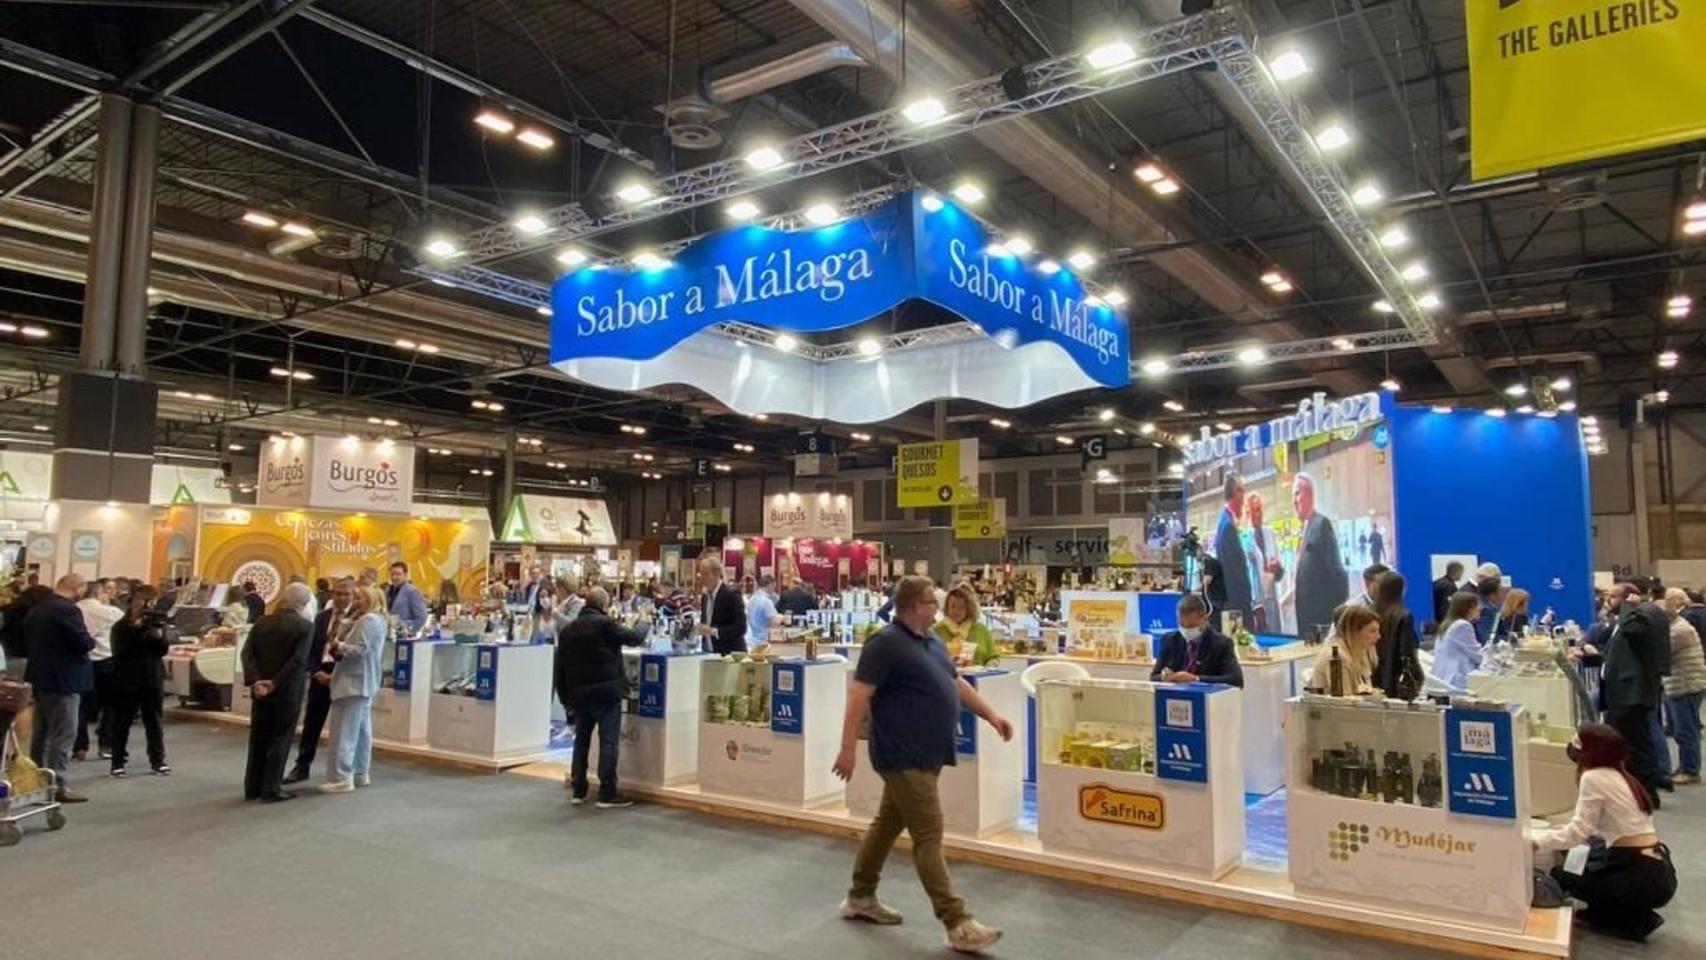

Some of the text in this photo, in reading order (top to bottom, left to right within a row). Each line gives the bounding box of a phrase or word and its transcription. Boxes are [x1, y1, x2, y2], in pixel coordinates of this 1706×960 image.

[1498, 0, 1680, 58] THE GALLERIES
[576, 244, 874, 338] Sabor a Málaga
[949, 238, 1120, 366] Sabor a Málaga
[1183, 391, 1384, 466] sabor a málaga
[808, 437, 817, 451] 8
[902, 444, 945, 462] GOURMET
[1087, 438, 1102, 457] G
[266, 458, 305, 487] Burgos
[329, 460, 399, 488] Burgos
[698, 460, 707, 475] E
[902, 463, 937, 481] QUESOS
[770, 507, 806, 525] Burgos
[1055, 537, 1110, 554] servic
[1100, 799, 1158, 823] Safrina
[1375, 826, 1477, 855] Mudéjar
